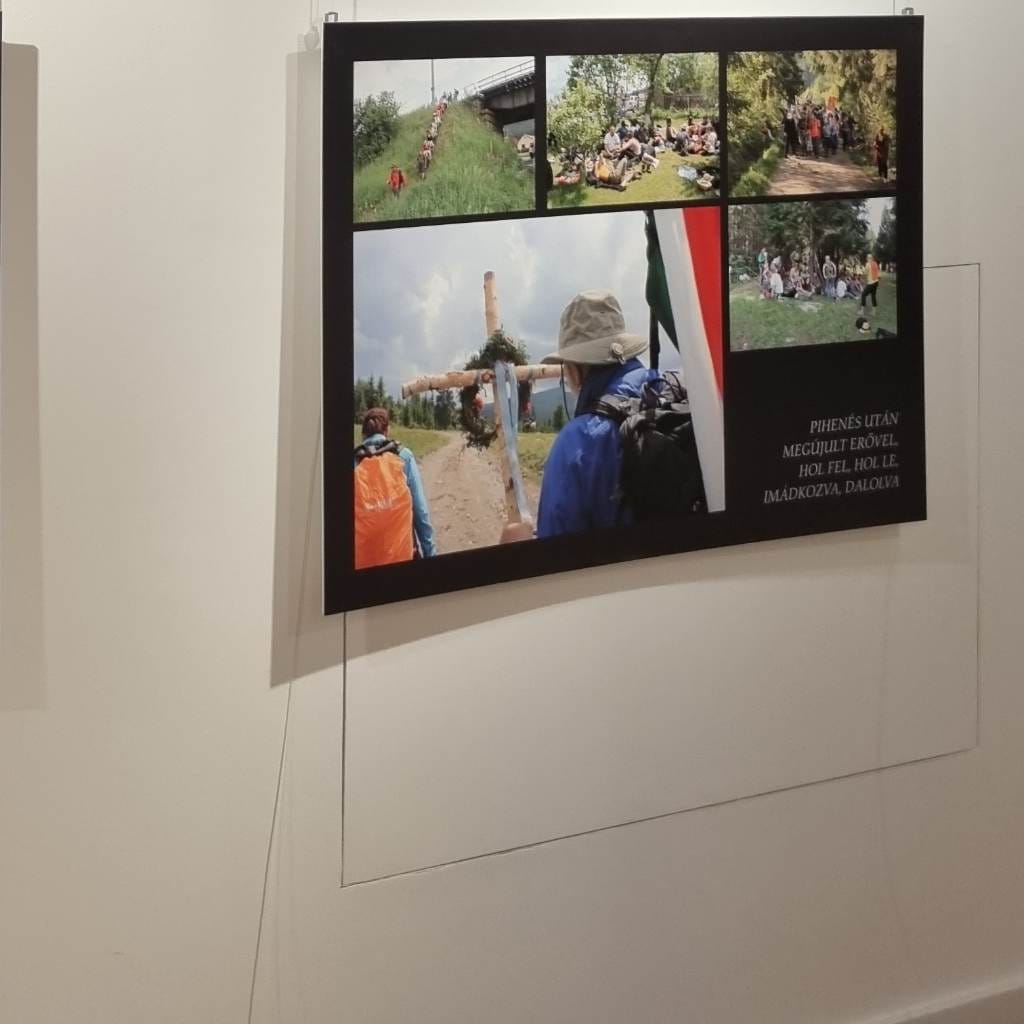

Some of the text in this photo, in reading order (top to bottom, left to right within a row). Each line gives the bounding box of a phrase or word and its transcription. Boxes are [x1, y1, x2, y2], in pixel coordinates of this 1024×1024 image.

[810, 410, 900, 434] PIHENÉS UTÁN
[783, 438, 848, 459] MEGÚJULT
[799, 463, 825, 478] HOL
[854, 456, 878, 471] HOL
[763, 475, 900, 504] IMÁDKOZVA, DALOLVA
